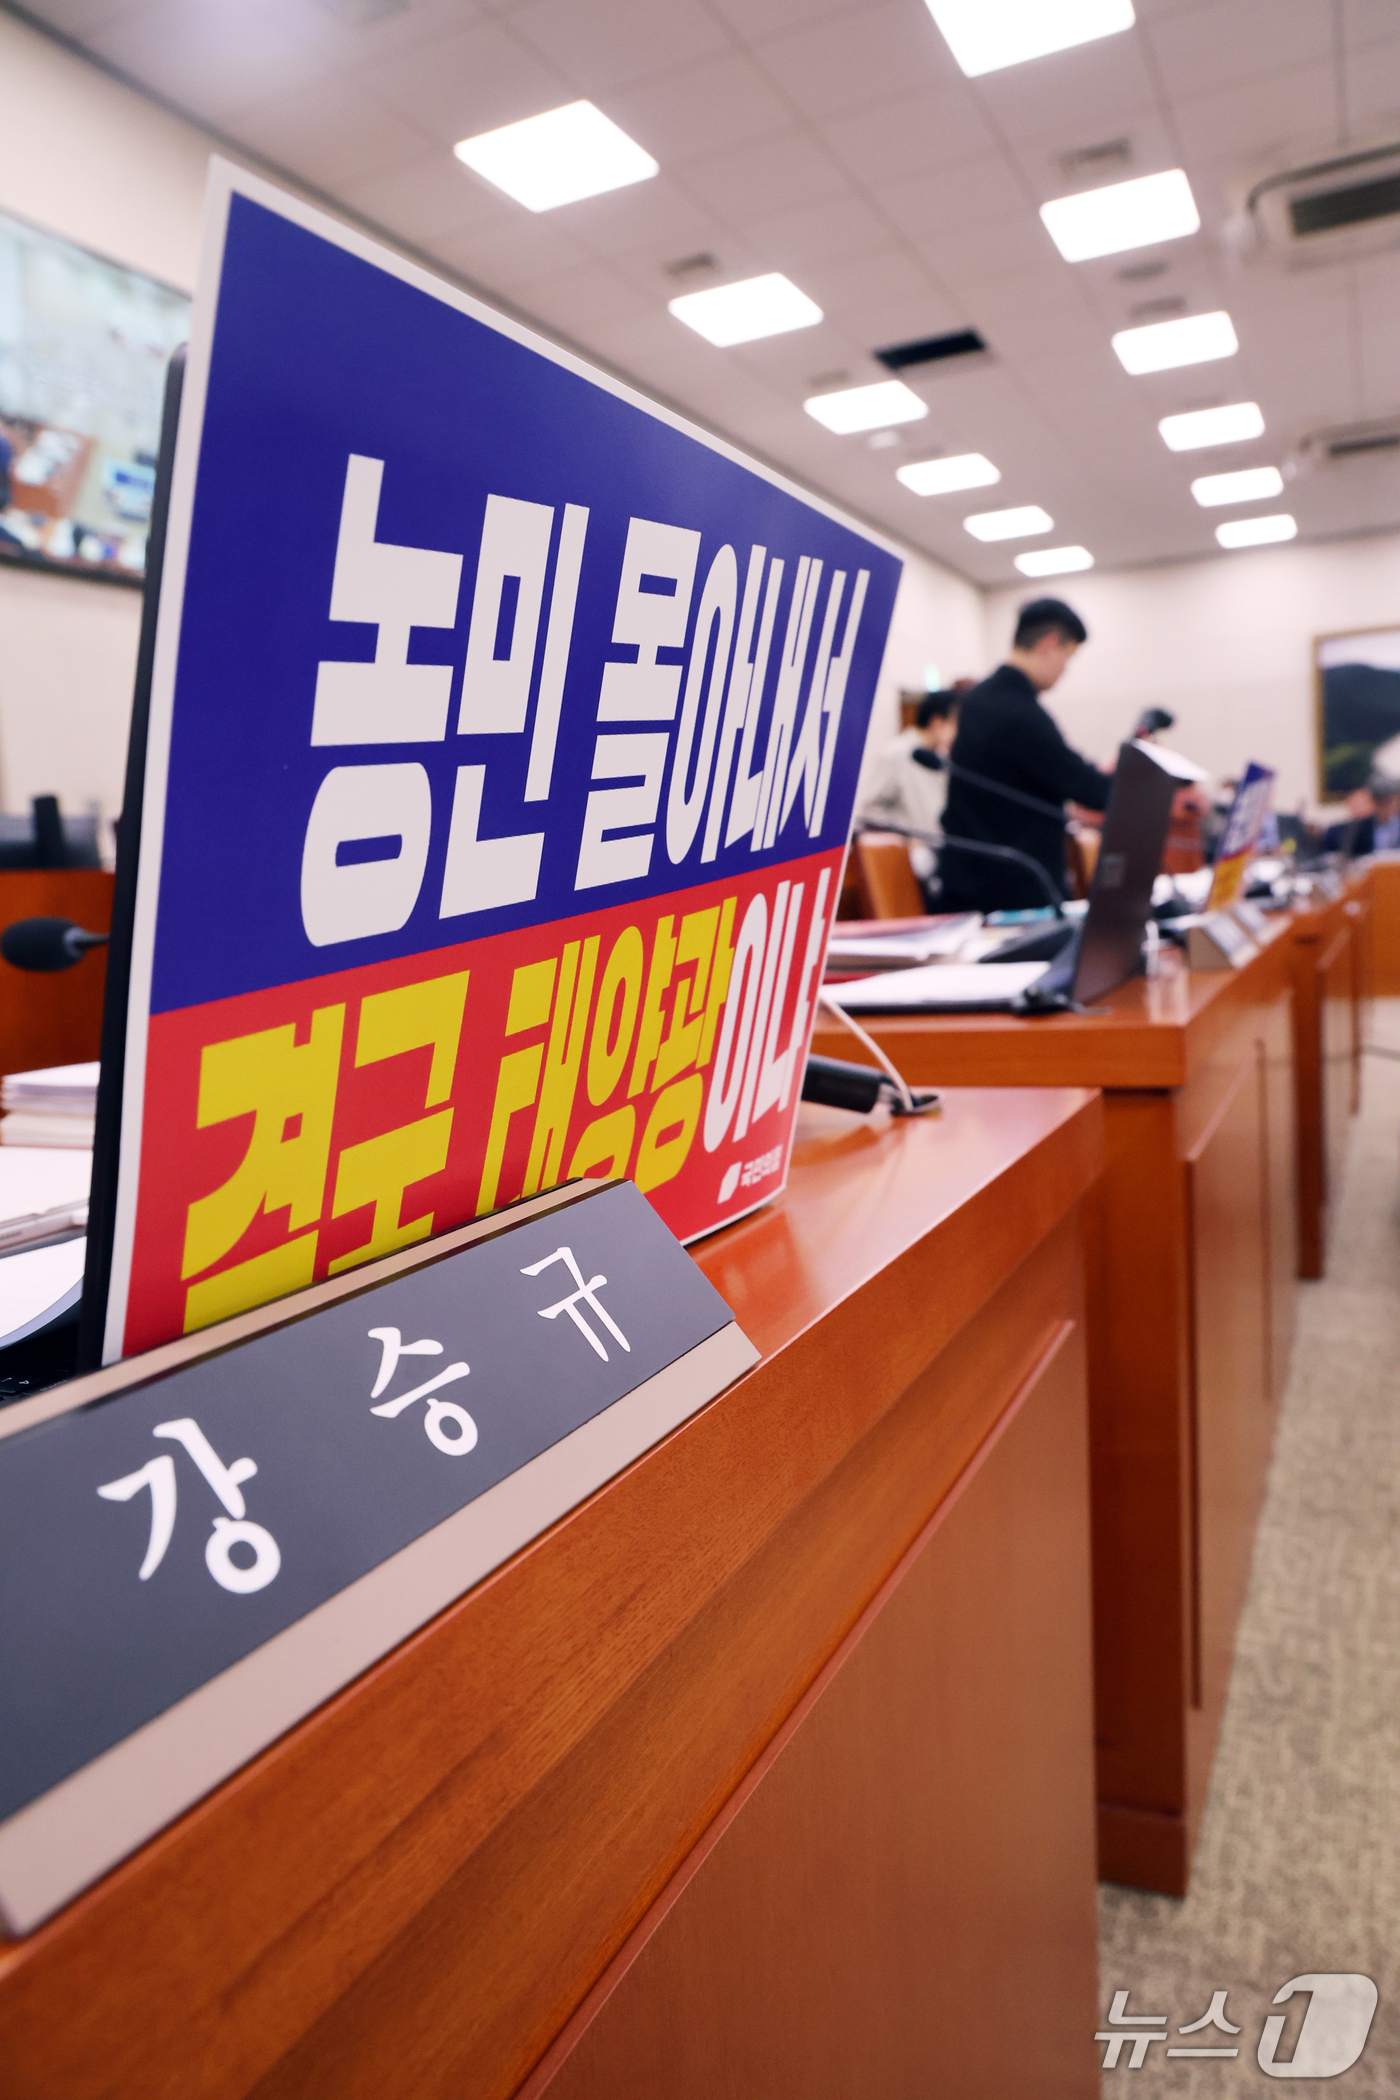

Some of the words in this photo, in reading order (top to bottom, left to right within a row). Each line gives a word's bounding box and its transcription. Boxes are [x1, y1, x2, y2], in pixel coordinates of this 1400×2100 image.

[301, 453, 590, 947] 농민
[574, 516, 870, 891] 몰아내서
[181, 969, 470, 1334] 결국
